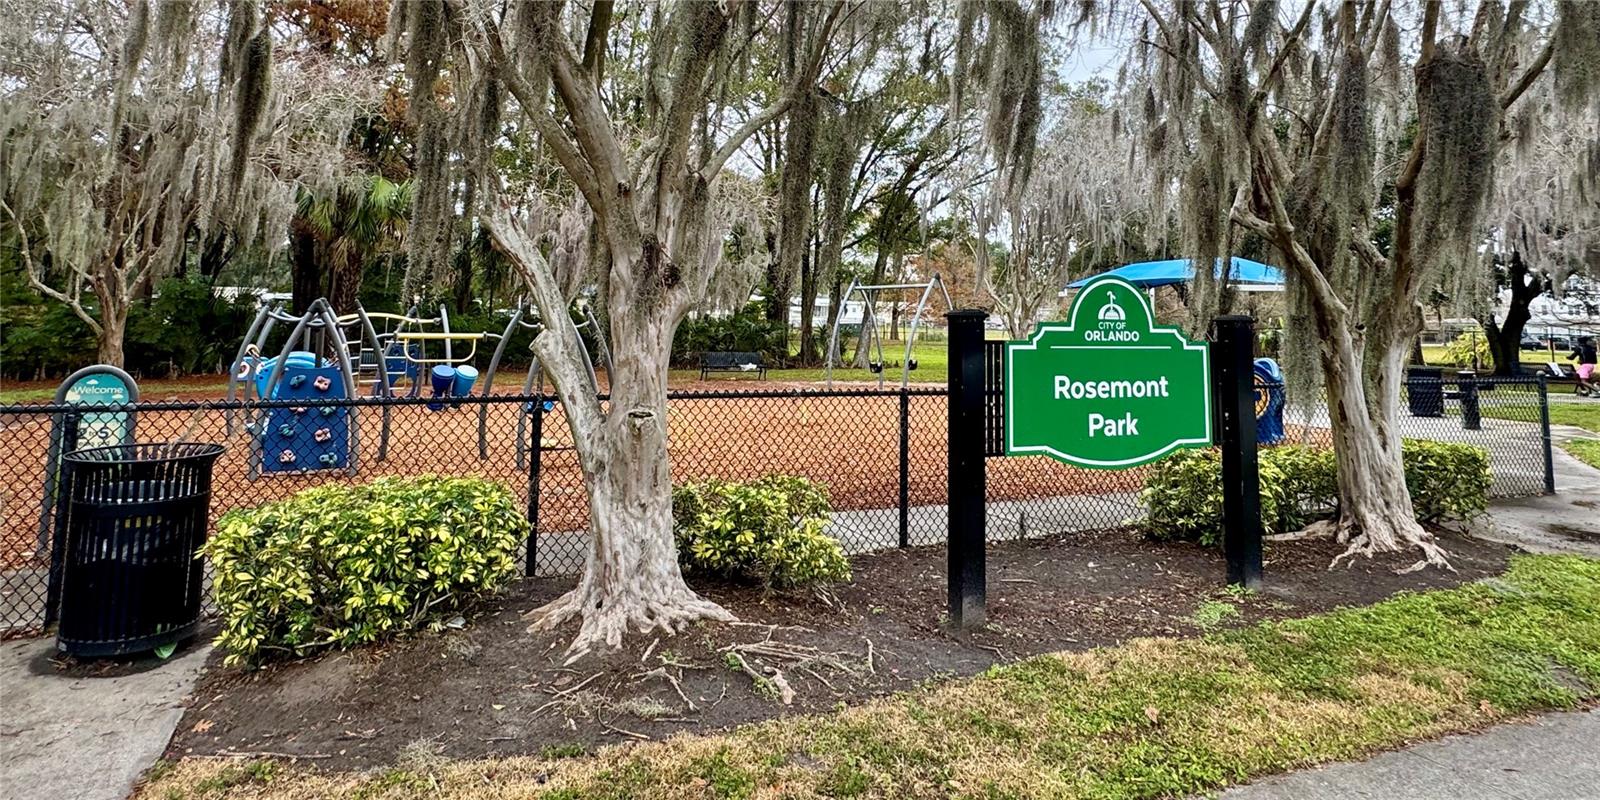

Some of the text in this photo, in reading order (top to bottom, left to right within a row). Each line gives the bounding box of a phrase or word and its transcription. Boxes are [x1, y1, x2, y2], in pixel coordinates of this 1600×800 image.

[1098, 321, 1126, 330] CITY OF
[1084, 330, 1140, 342] ORLANDO
[74, 386, 124, 394] Welcome
[1054, 375, 1169, 400] Rosemont
[1088, 412, 1139, 438] Park
